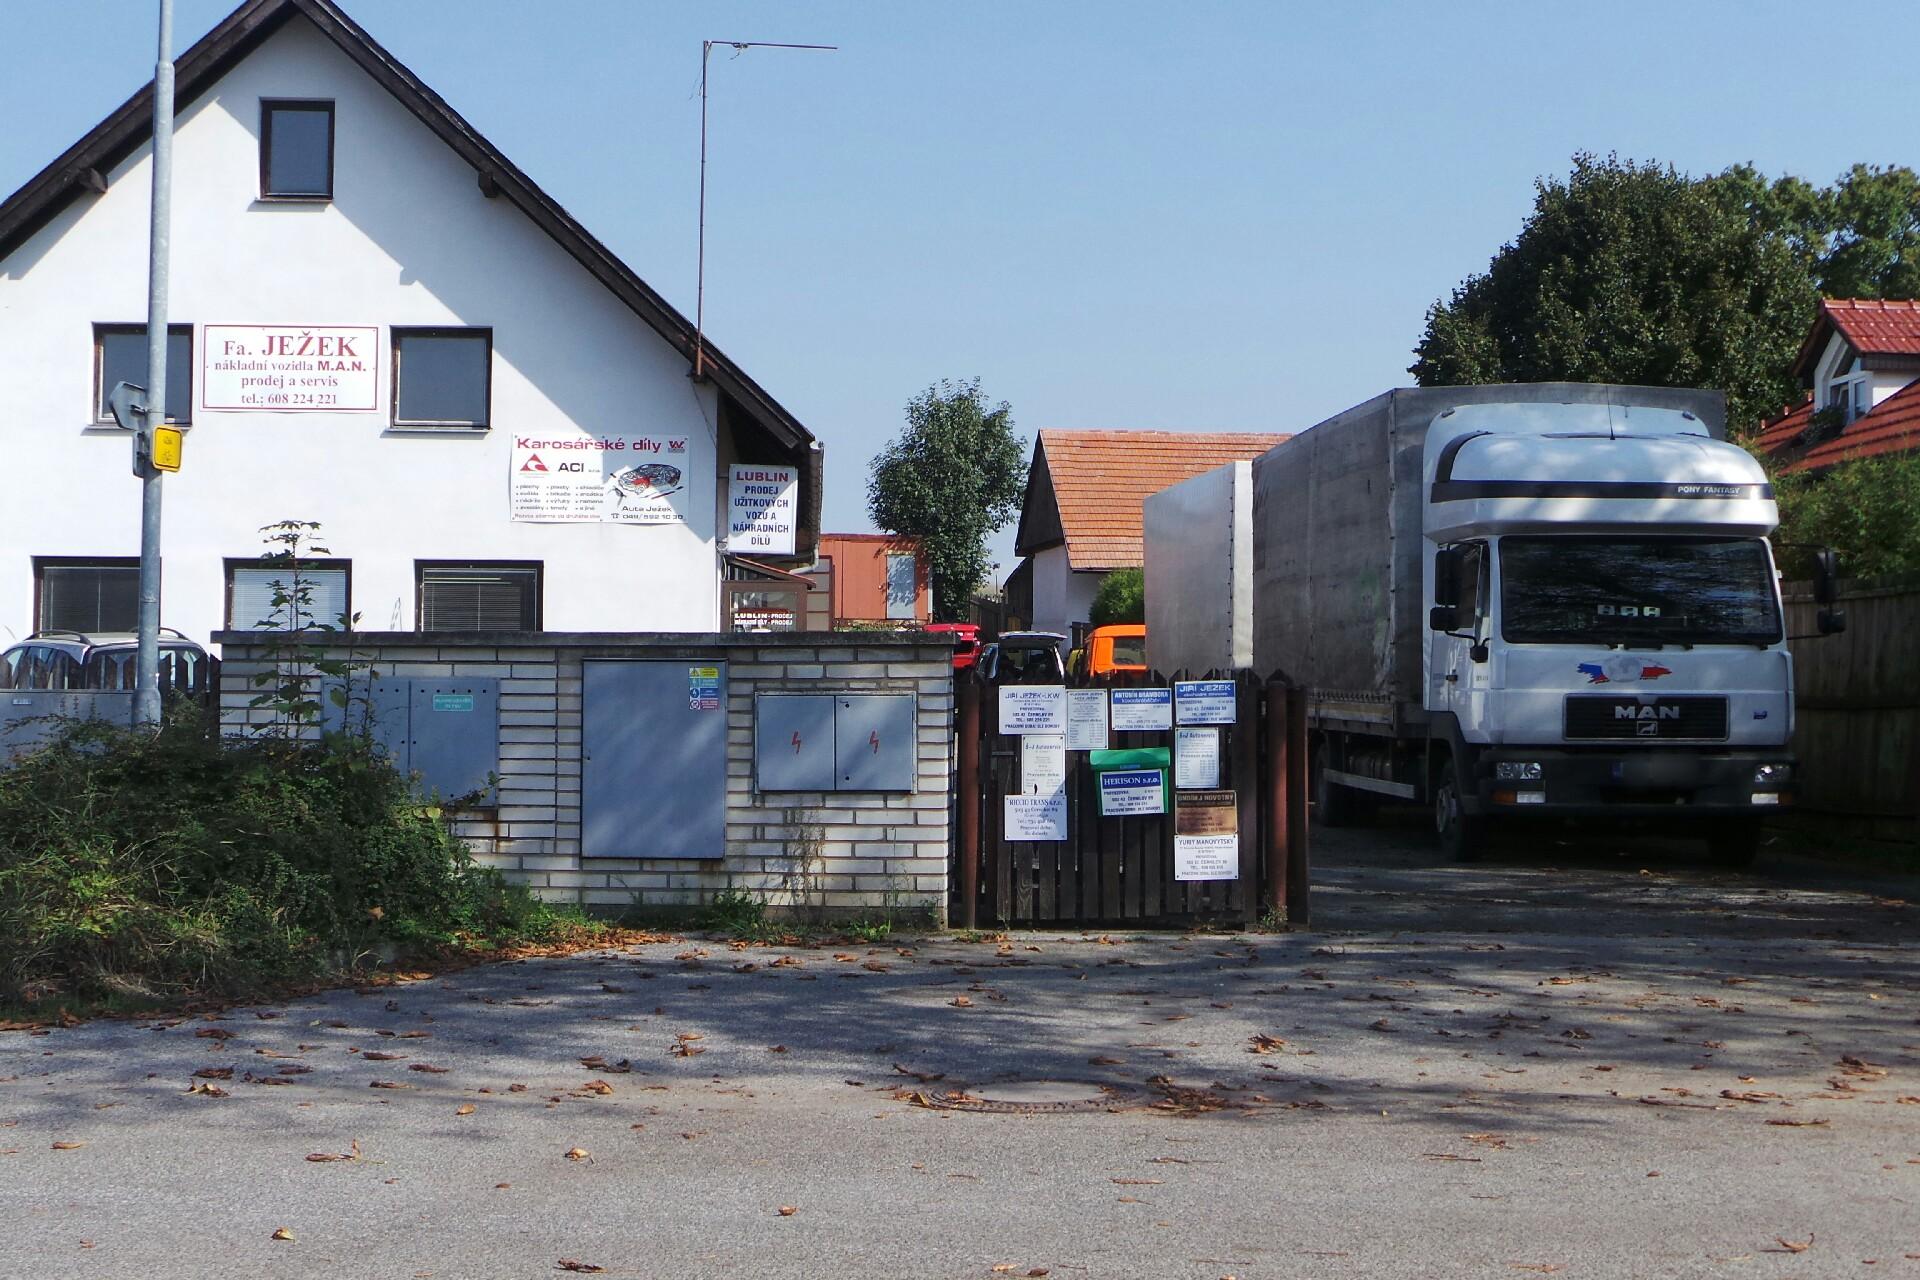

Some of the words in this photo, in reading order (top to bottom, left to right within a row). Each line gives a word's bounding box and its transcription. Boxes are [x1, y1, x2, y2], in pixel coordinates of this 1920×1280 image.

[224, 340, 253, 356] Fa.
[262, 330, 358, 357] JEŽEK
[214, 360, 267, 371] nákladní
[271, 360, 313, 371] vozidla
[317, 360, 366, 371] M.A.N.
[241, 375, 284, 389] prodej
[288, 377, 296, 386] a
[300, 375, 338, 387] servis
[241, 393, 264, 404] tel.:
[267, 394, 289, 404] 608
[293, 394, 313, 404] 224
[317, 394, 337, 405] 221
[517, 437, 625, 451] Karosářské
[632, 438, 662, 453] díly
[558, 462, 585, 472] ACI
[736, 471, 789, 482] LUBLIN
[745, 485, 779, 495] PRODEJ
[1703, 486, 1741, 494] FANTASY
[734, 496, 789, 508] UŽITKOVÝCH
[745, 509, 768, 520] VOZŮ
[770, 512, 776, 520] A
[733, 521, 789, 533] NÁHRADNÍCH
[751, 534, 771, 546] DÍLŮ
[1614, 705, 1680, 719] MAN
[1104, 777, 1141, 786] HERISON
